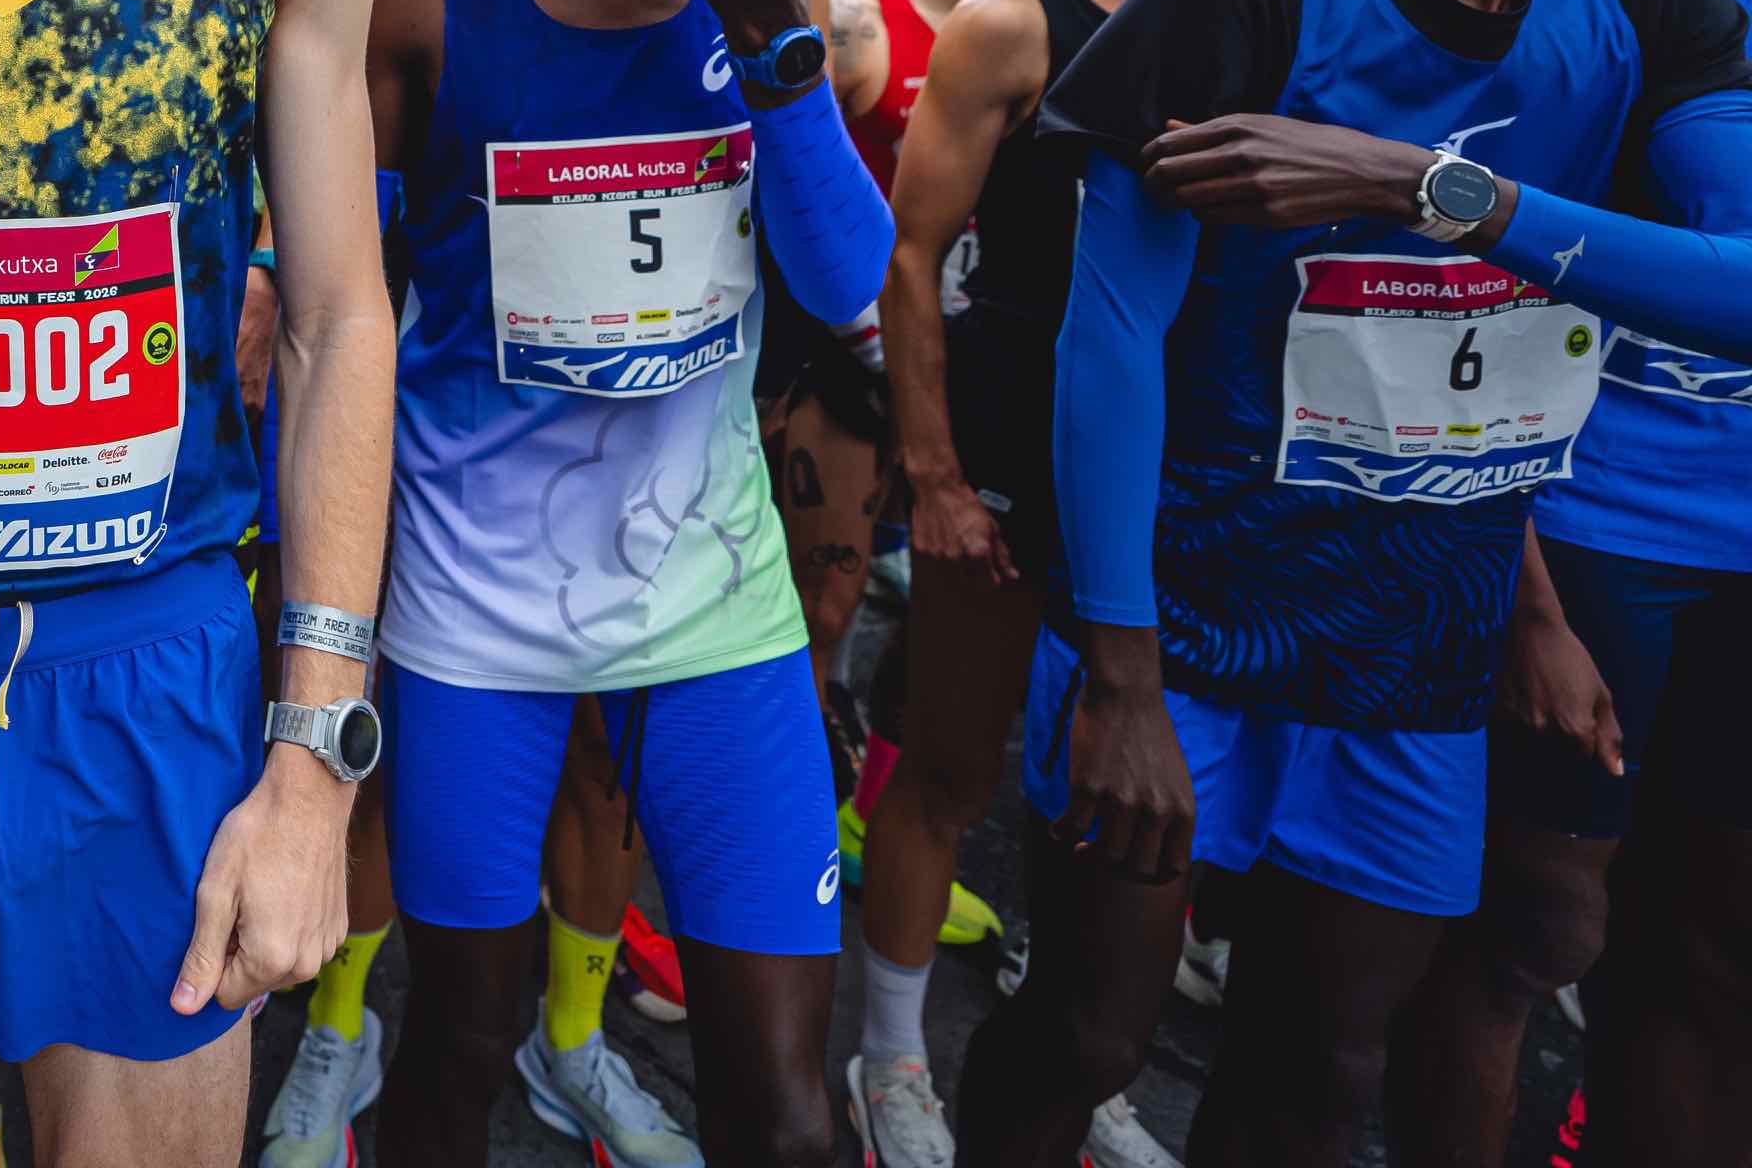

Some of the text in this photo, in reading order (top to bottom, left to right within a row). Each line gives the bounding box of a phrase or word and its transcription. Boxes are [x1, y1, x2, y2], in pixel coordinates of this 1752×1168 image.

[548, 161, 686, 182] LABORAL kutxa
[629, 208, 663, 273] 5
[0, 293, 29, 305] RUN
[38, 291, 76, 303] FEST
[83, 286, 119, 300] 2026
[1362, 279, 1508, 299] LABORAL kutxa
[1449, 327, 1482, 391] 6
[111, 472, 132, 486] BM
[324, 618, 350, 635] AREA
